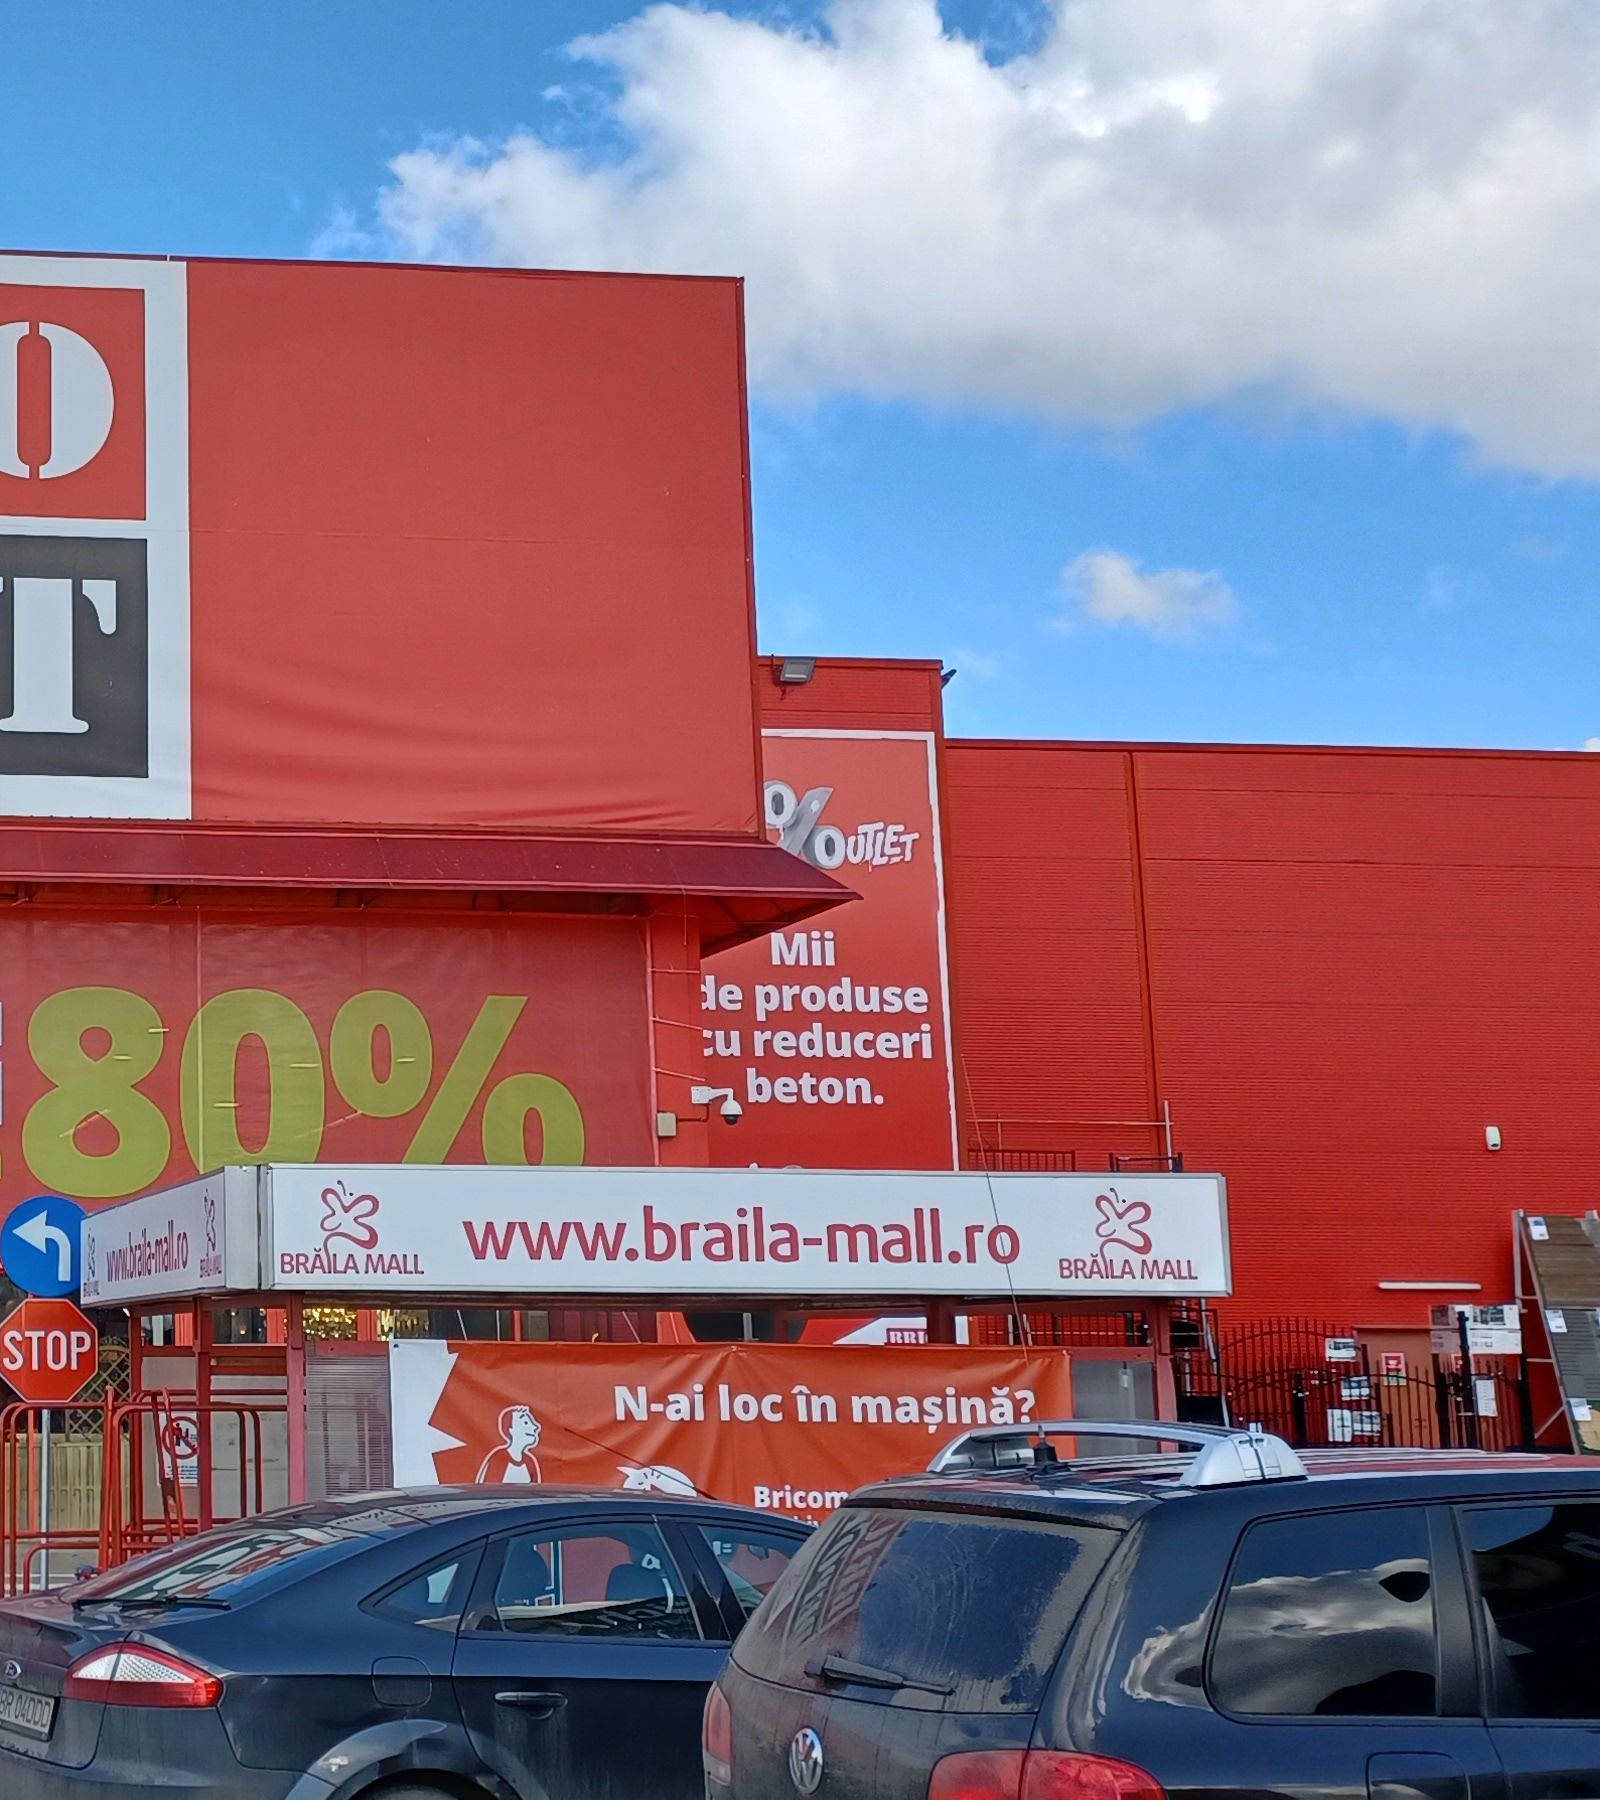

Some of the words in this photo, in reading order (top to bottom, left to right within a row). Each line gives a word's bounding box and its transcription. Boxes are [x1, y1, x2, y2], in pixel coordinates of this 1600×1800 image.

[770, 931, 835, 966] Mii
[755, 976, 928, 1021] produse
[754, 1022, 932, 1060] reduceri
[22, 985, 586, 1198] 80%
[747, 1067, 884, 1105] beton.
[106, 1219, 189, 1283] www.braila-mall.ro
[462, 1204, 1021, 1265] www.braila-mall.ro
[364, 1253, 425, 1275] MALL
[1140, 1258, 1198, 1280] MALL
[2, 1330, 92, 1371] STOP
[613, 1384, 705, 1422] N-ai
[718, 1383, 782, 1422] loc
[791, 1385, 837, 1423] în
[851, 1385, 1038, 1435] mașină?
